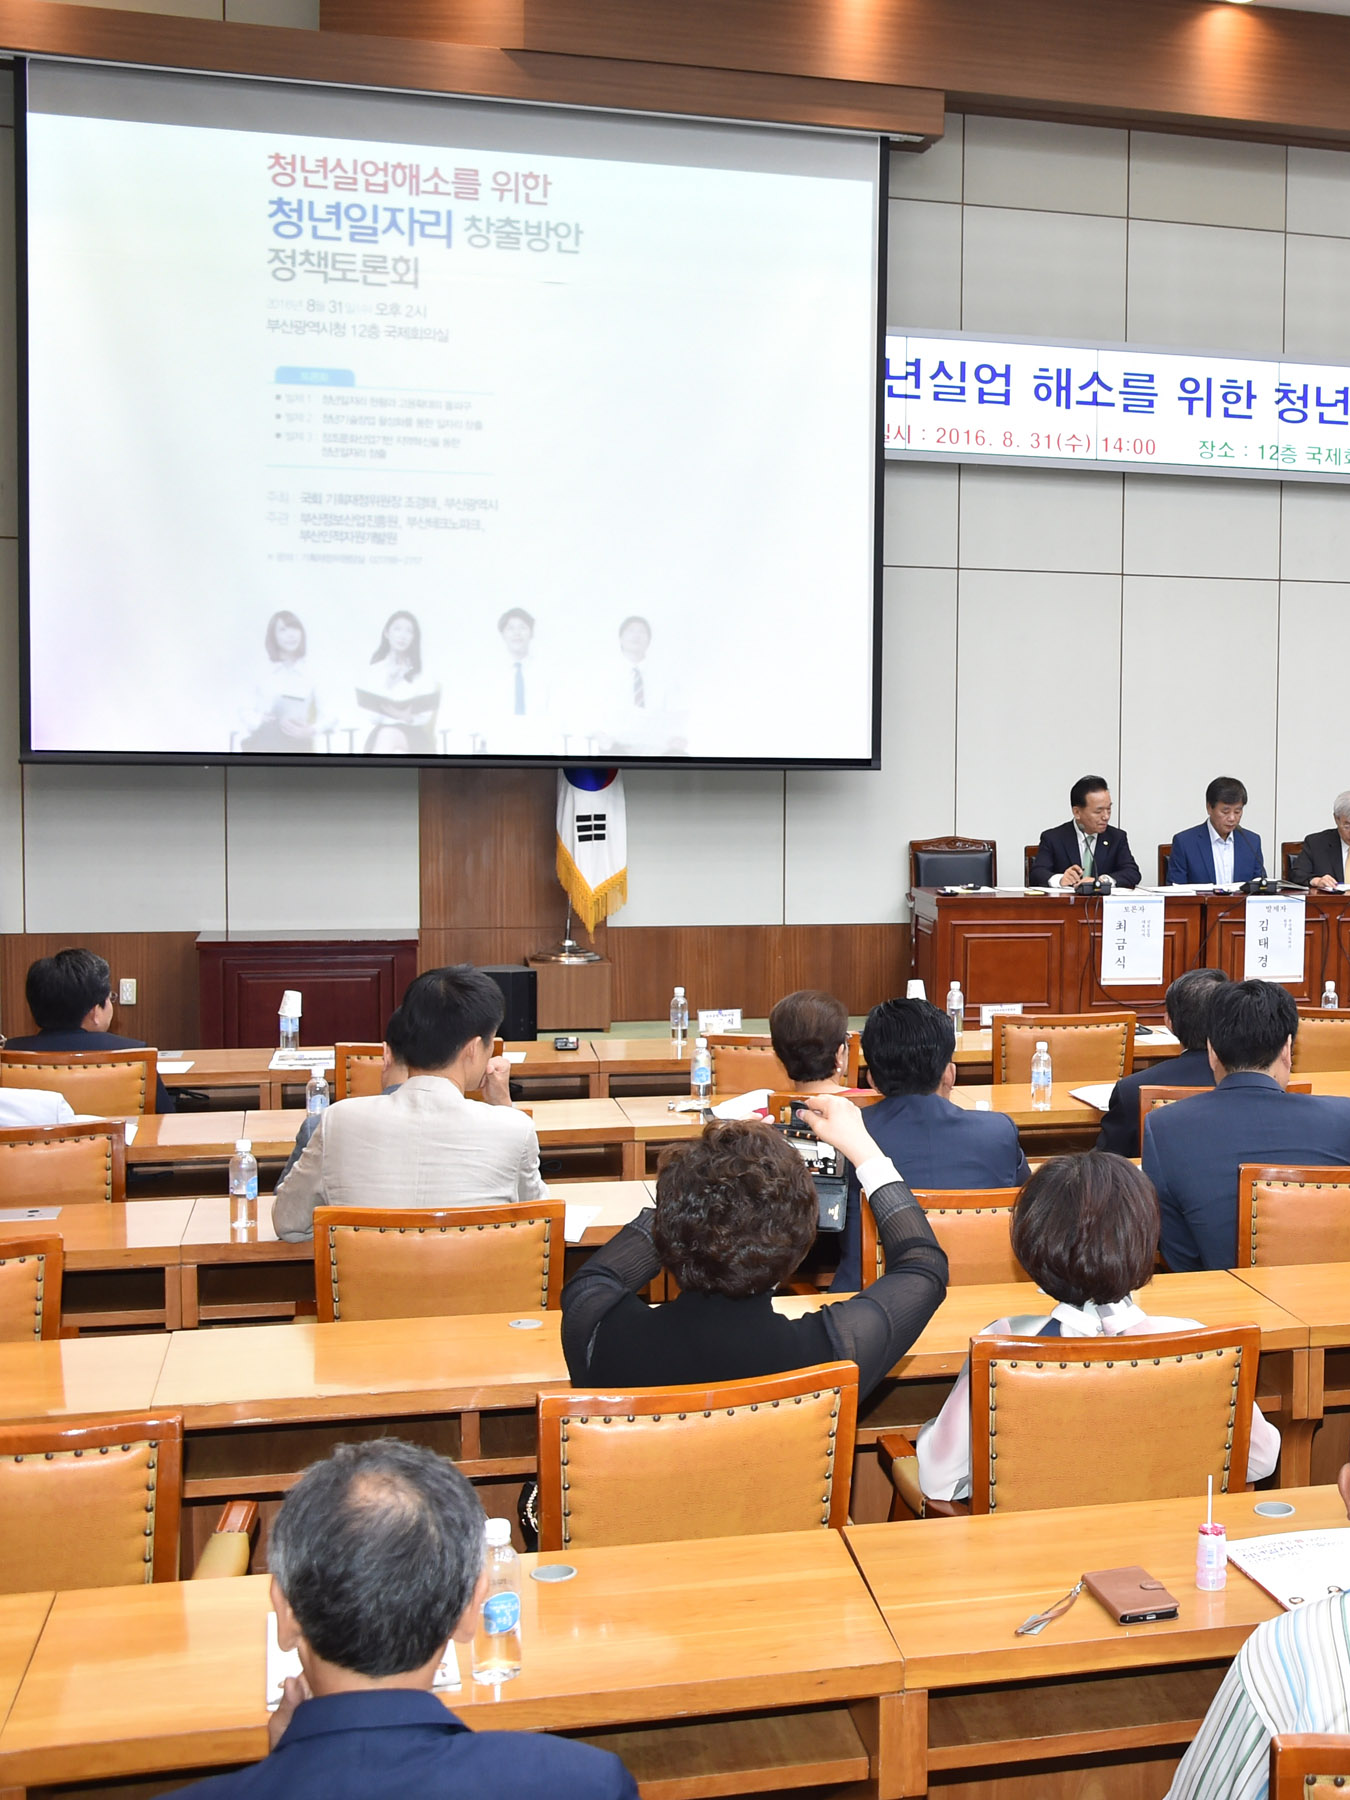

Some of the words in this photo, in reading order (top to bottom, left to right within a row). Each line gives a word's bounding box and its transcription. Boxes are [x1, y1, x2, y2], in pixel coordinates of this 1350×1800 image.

[267, 152, 482, 201] 청년실업해소를
[490, 170, 552, 206] 위한
[267, 197, 453, 249] 청년일자리
[464, 214, 584, 255] 창출방안
[266, 248, 420, 289] 정책토론회
[266, 318, 347, 338] 부산광역시청
[351, 323, 380, 339] 12층
[384, 326, 449, 344] 국제회의실
[375, 303, 402, 317] 오후
[406, 306, 428, 319] 2시
[1033, 367, 1159, 414] 해소를
[1177, 377, 1257, 419] 위한
[935, 427, 992, 448] 2016.
[1003, 431, 1020, 449] 8.
[1030, 432, 1092, 453] 31(수)
[1102, 437, 1156, 456] 14:00
[1198, 440, 1236, 460] 장소
[1258, 444, 1298, 465] 12층
[1258, 918, 1269, 968] 김태경
